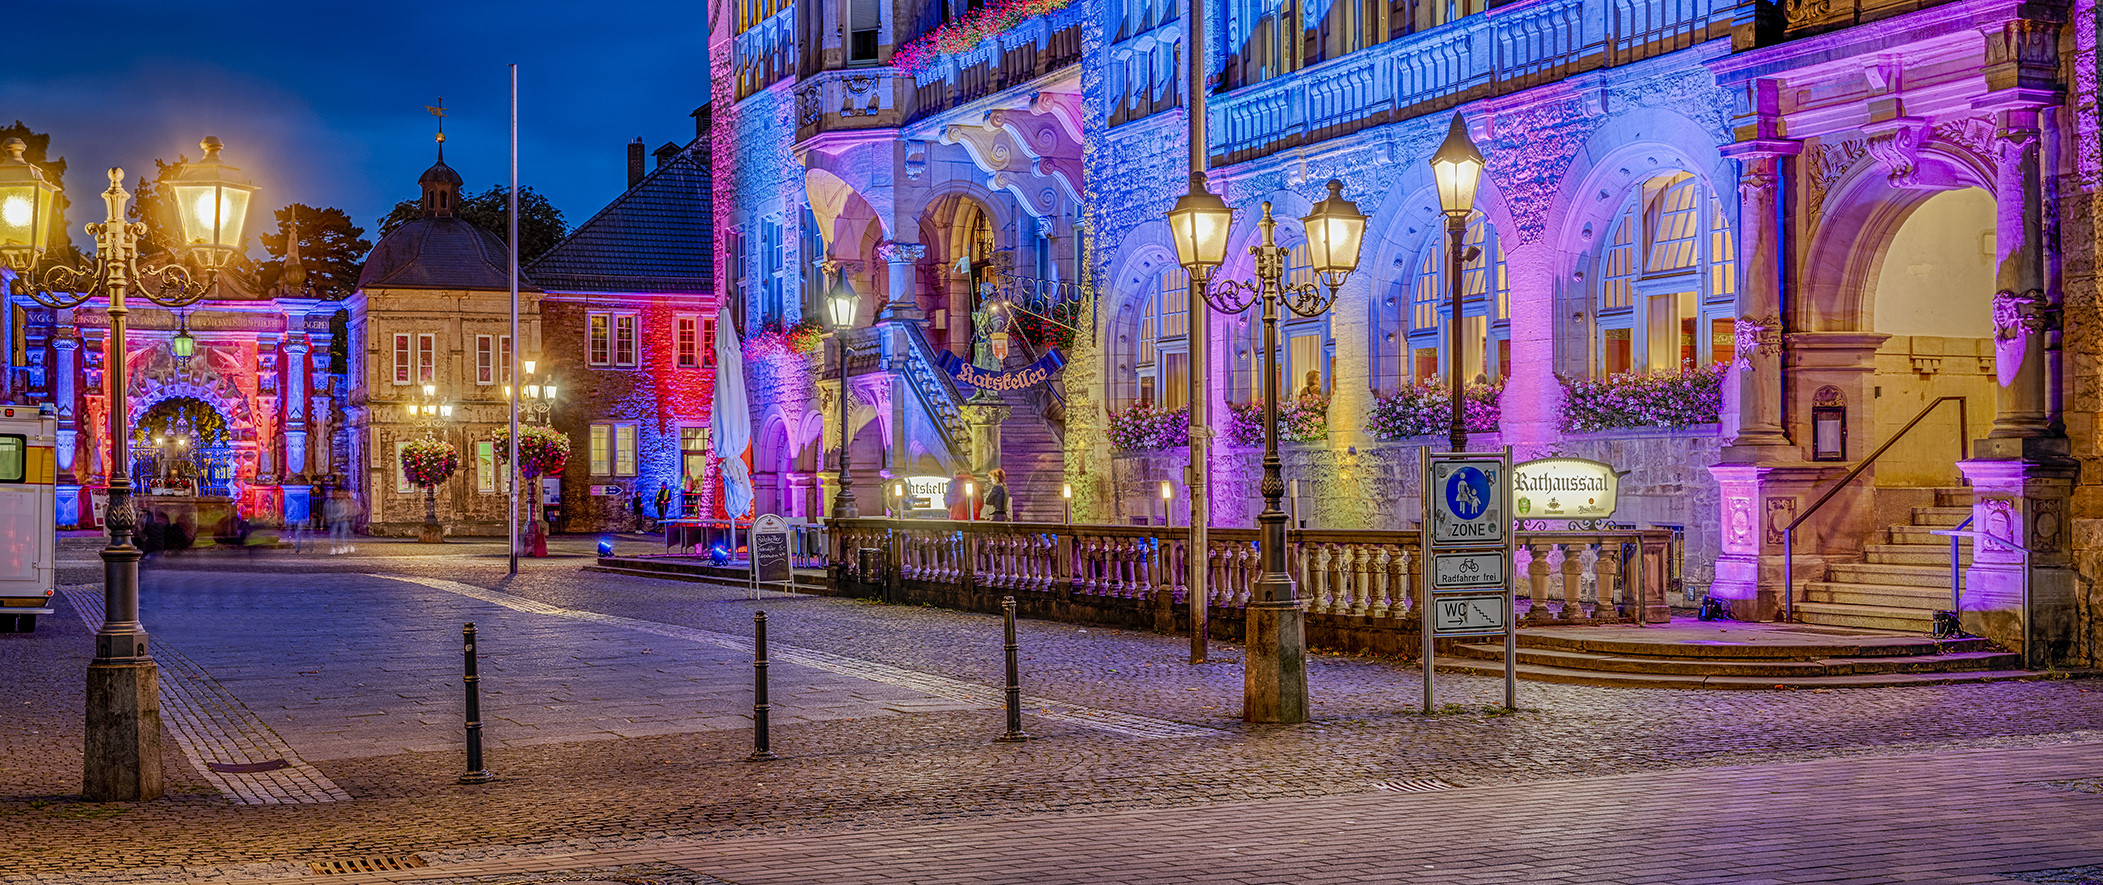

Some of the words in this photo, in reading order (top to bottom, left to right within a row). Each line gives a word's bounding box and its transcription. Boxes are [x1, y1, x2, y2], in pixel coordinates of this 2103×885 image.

[957, 362, 1048, 391] Ratskeller
[1514, 472, 1609, 494] Rathaussaal
[1452, 523, 1486, 537] ZONE
[1442, 573, 1480, 583] Radfahrer
[1483, 572, 1497, 582] frei
[1444, 602, 1467, 617] WC
